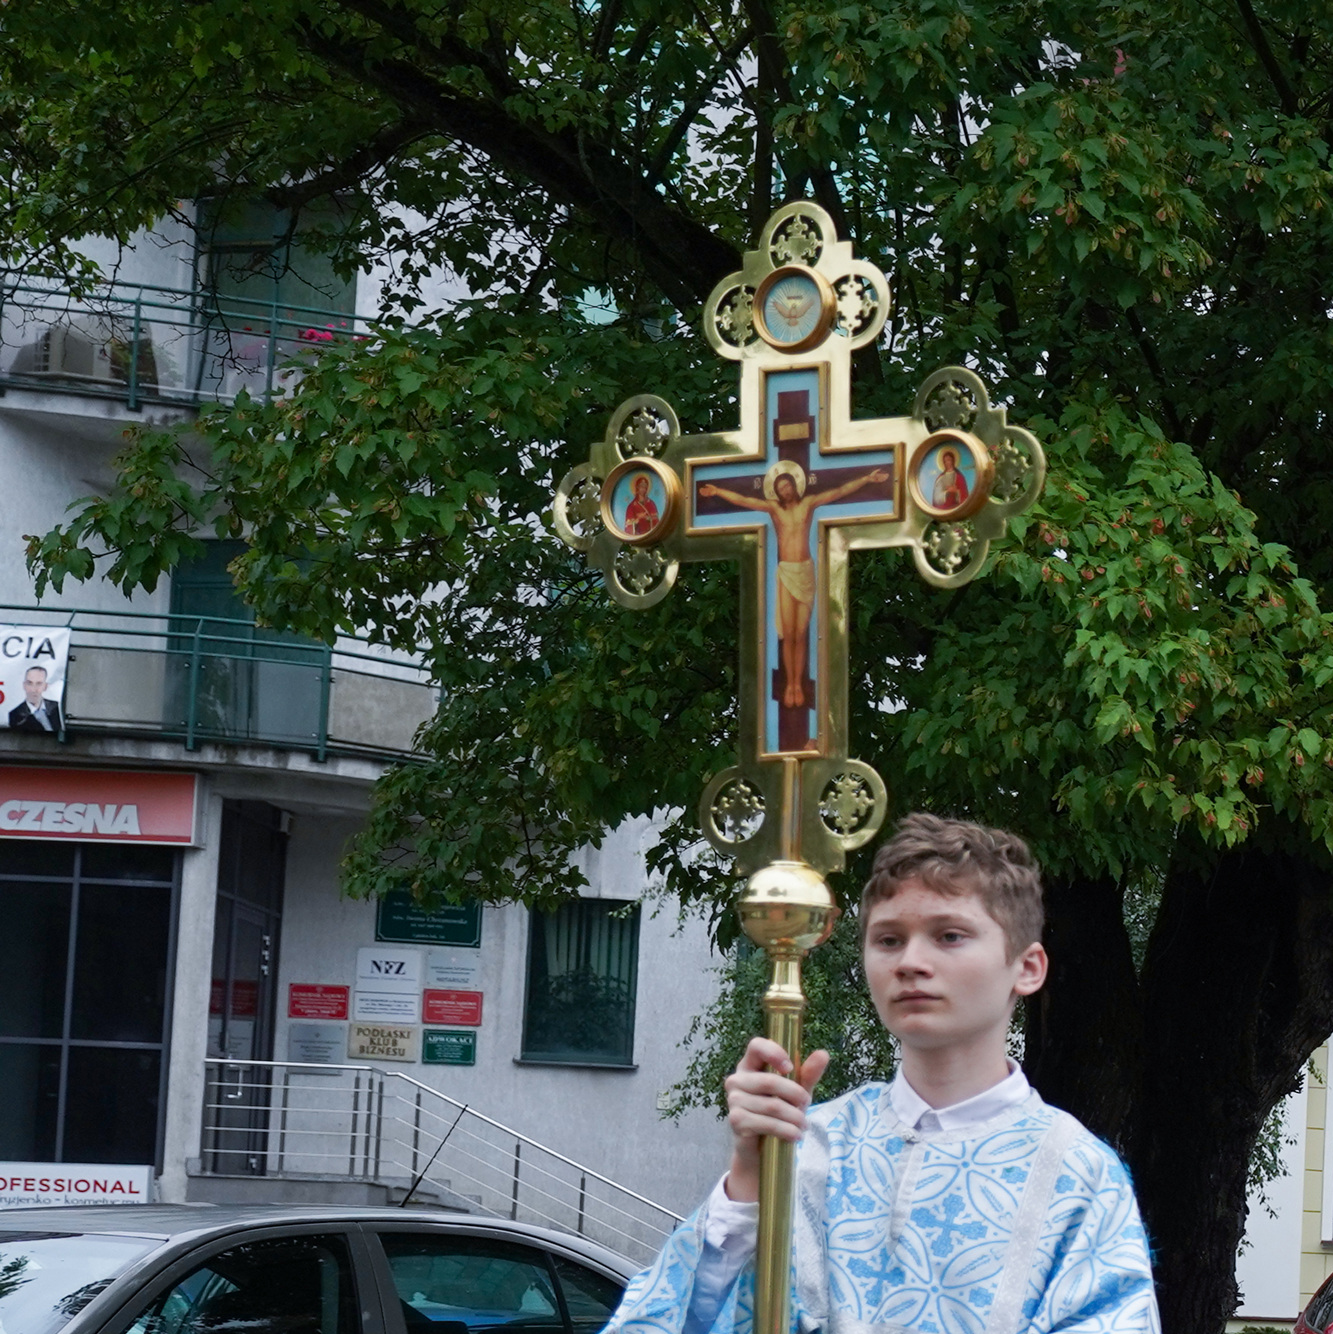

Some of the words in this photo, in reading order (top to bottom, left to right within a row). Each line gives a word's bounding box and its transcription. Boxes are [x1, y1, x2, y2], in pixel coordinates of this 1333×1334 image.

[370, 959, 406, 975] NFZ
[369, 1037, 398, 1047] KLUB
[359, 1045, 406, 1057] BIZNESU
